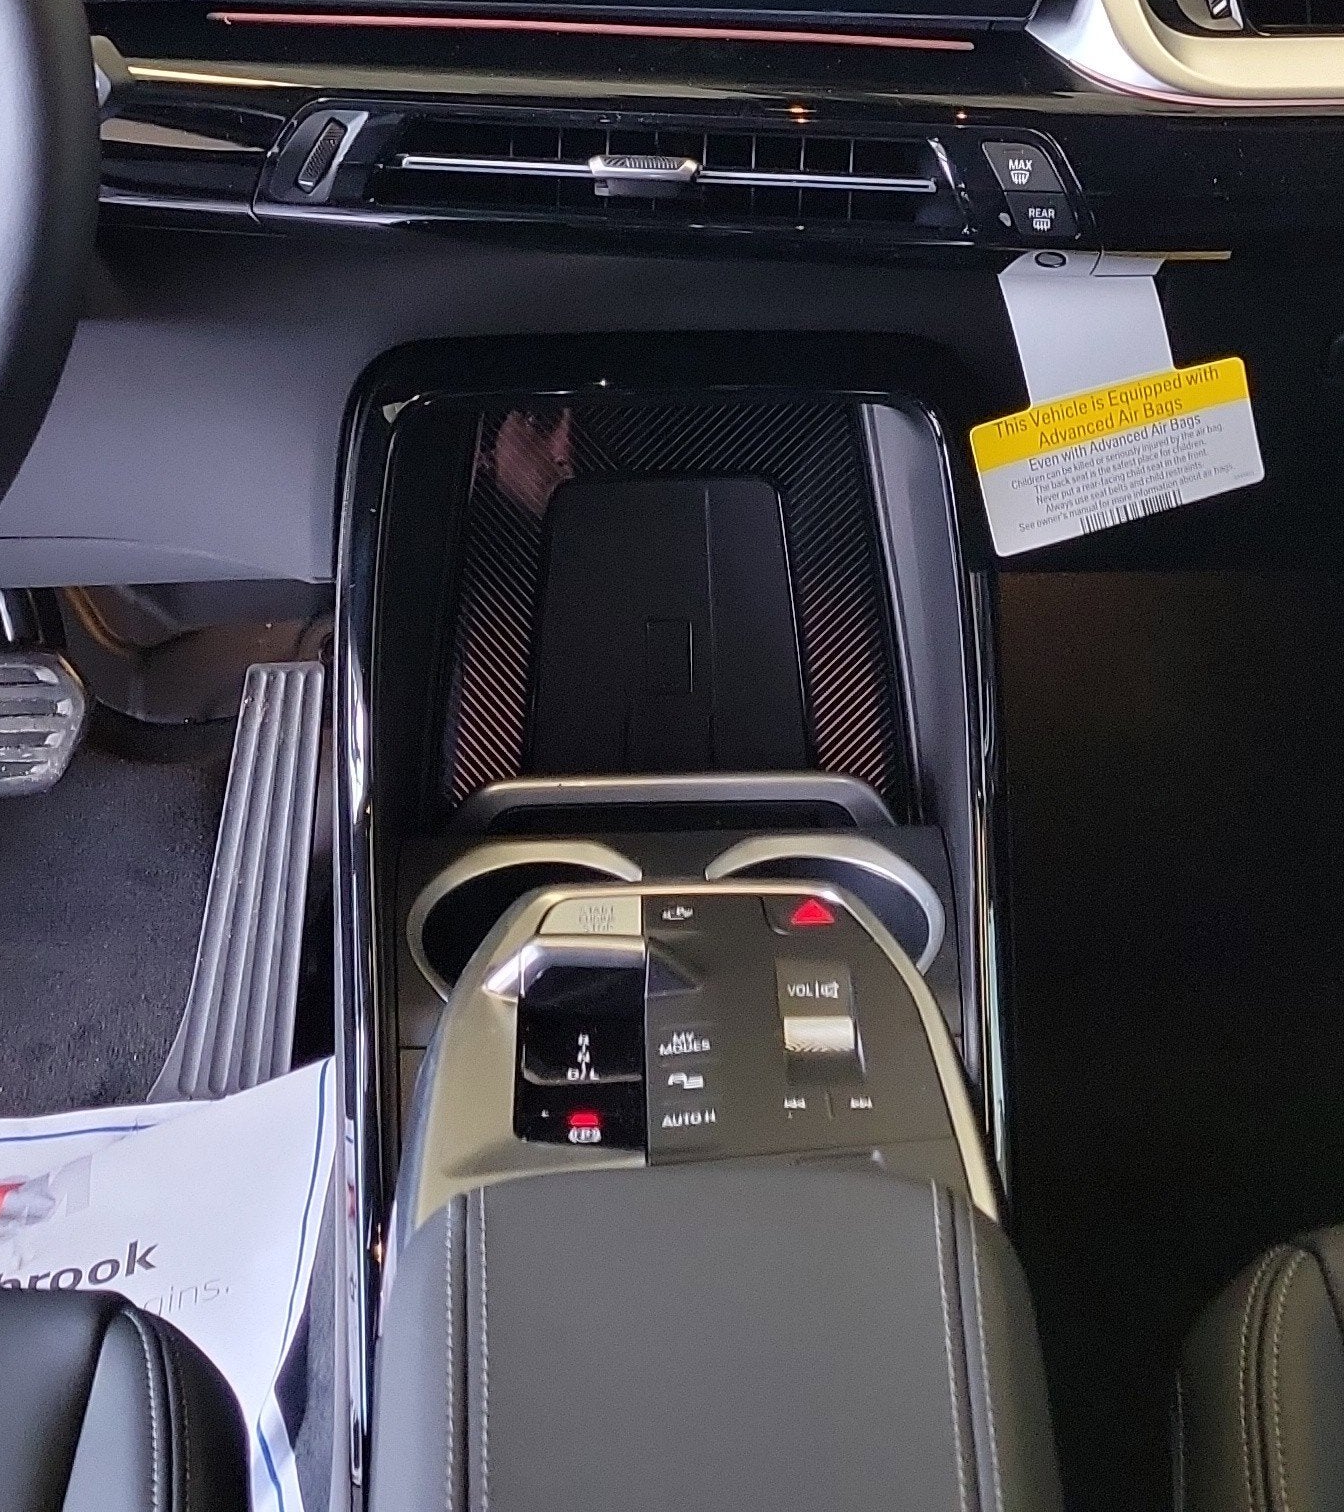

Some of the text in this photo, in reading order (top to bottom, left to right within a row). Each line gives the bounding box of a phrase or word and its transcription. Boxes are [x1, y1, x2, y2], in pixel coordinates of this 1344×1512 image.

[1008, 159, 1033, 171] MAX
[1028, 208, 1055, 220] REAR
[996, 366, 1219, 439] This Vehicle is Equipped with
[1039, 397, 1183, 448] Advanced Air Bags
[1029, 414, 1201, 472] Even with Advanced Air Bags
[1010, 472, 1045, 489] Children
[1045, 468, 1061, 479] can
[1072, 458, 1094, 471] killed
[1104, 445, 1141, 463] seriously
[1141, 436, 1169, 452] injured
[1180, 429, 1194, 439] the
[1033, 481, 1050, 493] The
[1097, 464, 1110, 475] the
[786, 982, 813, 997] VOL
[661, 1112, 702, 1128] AUTO
